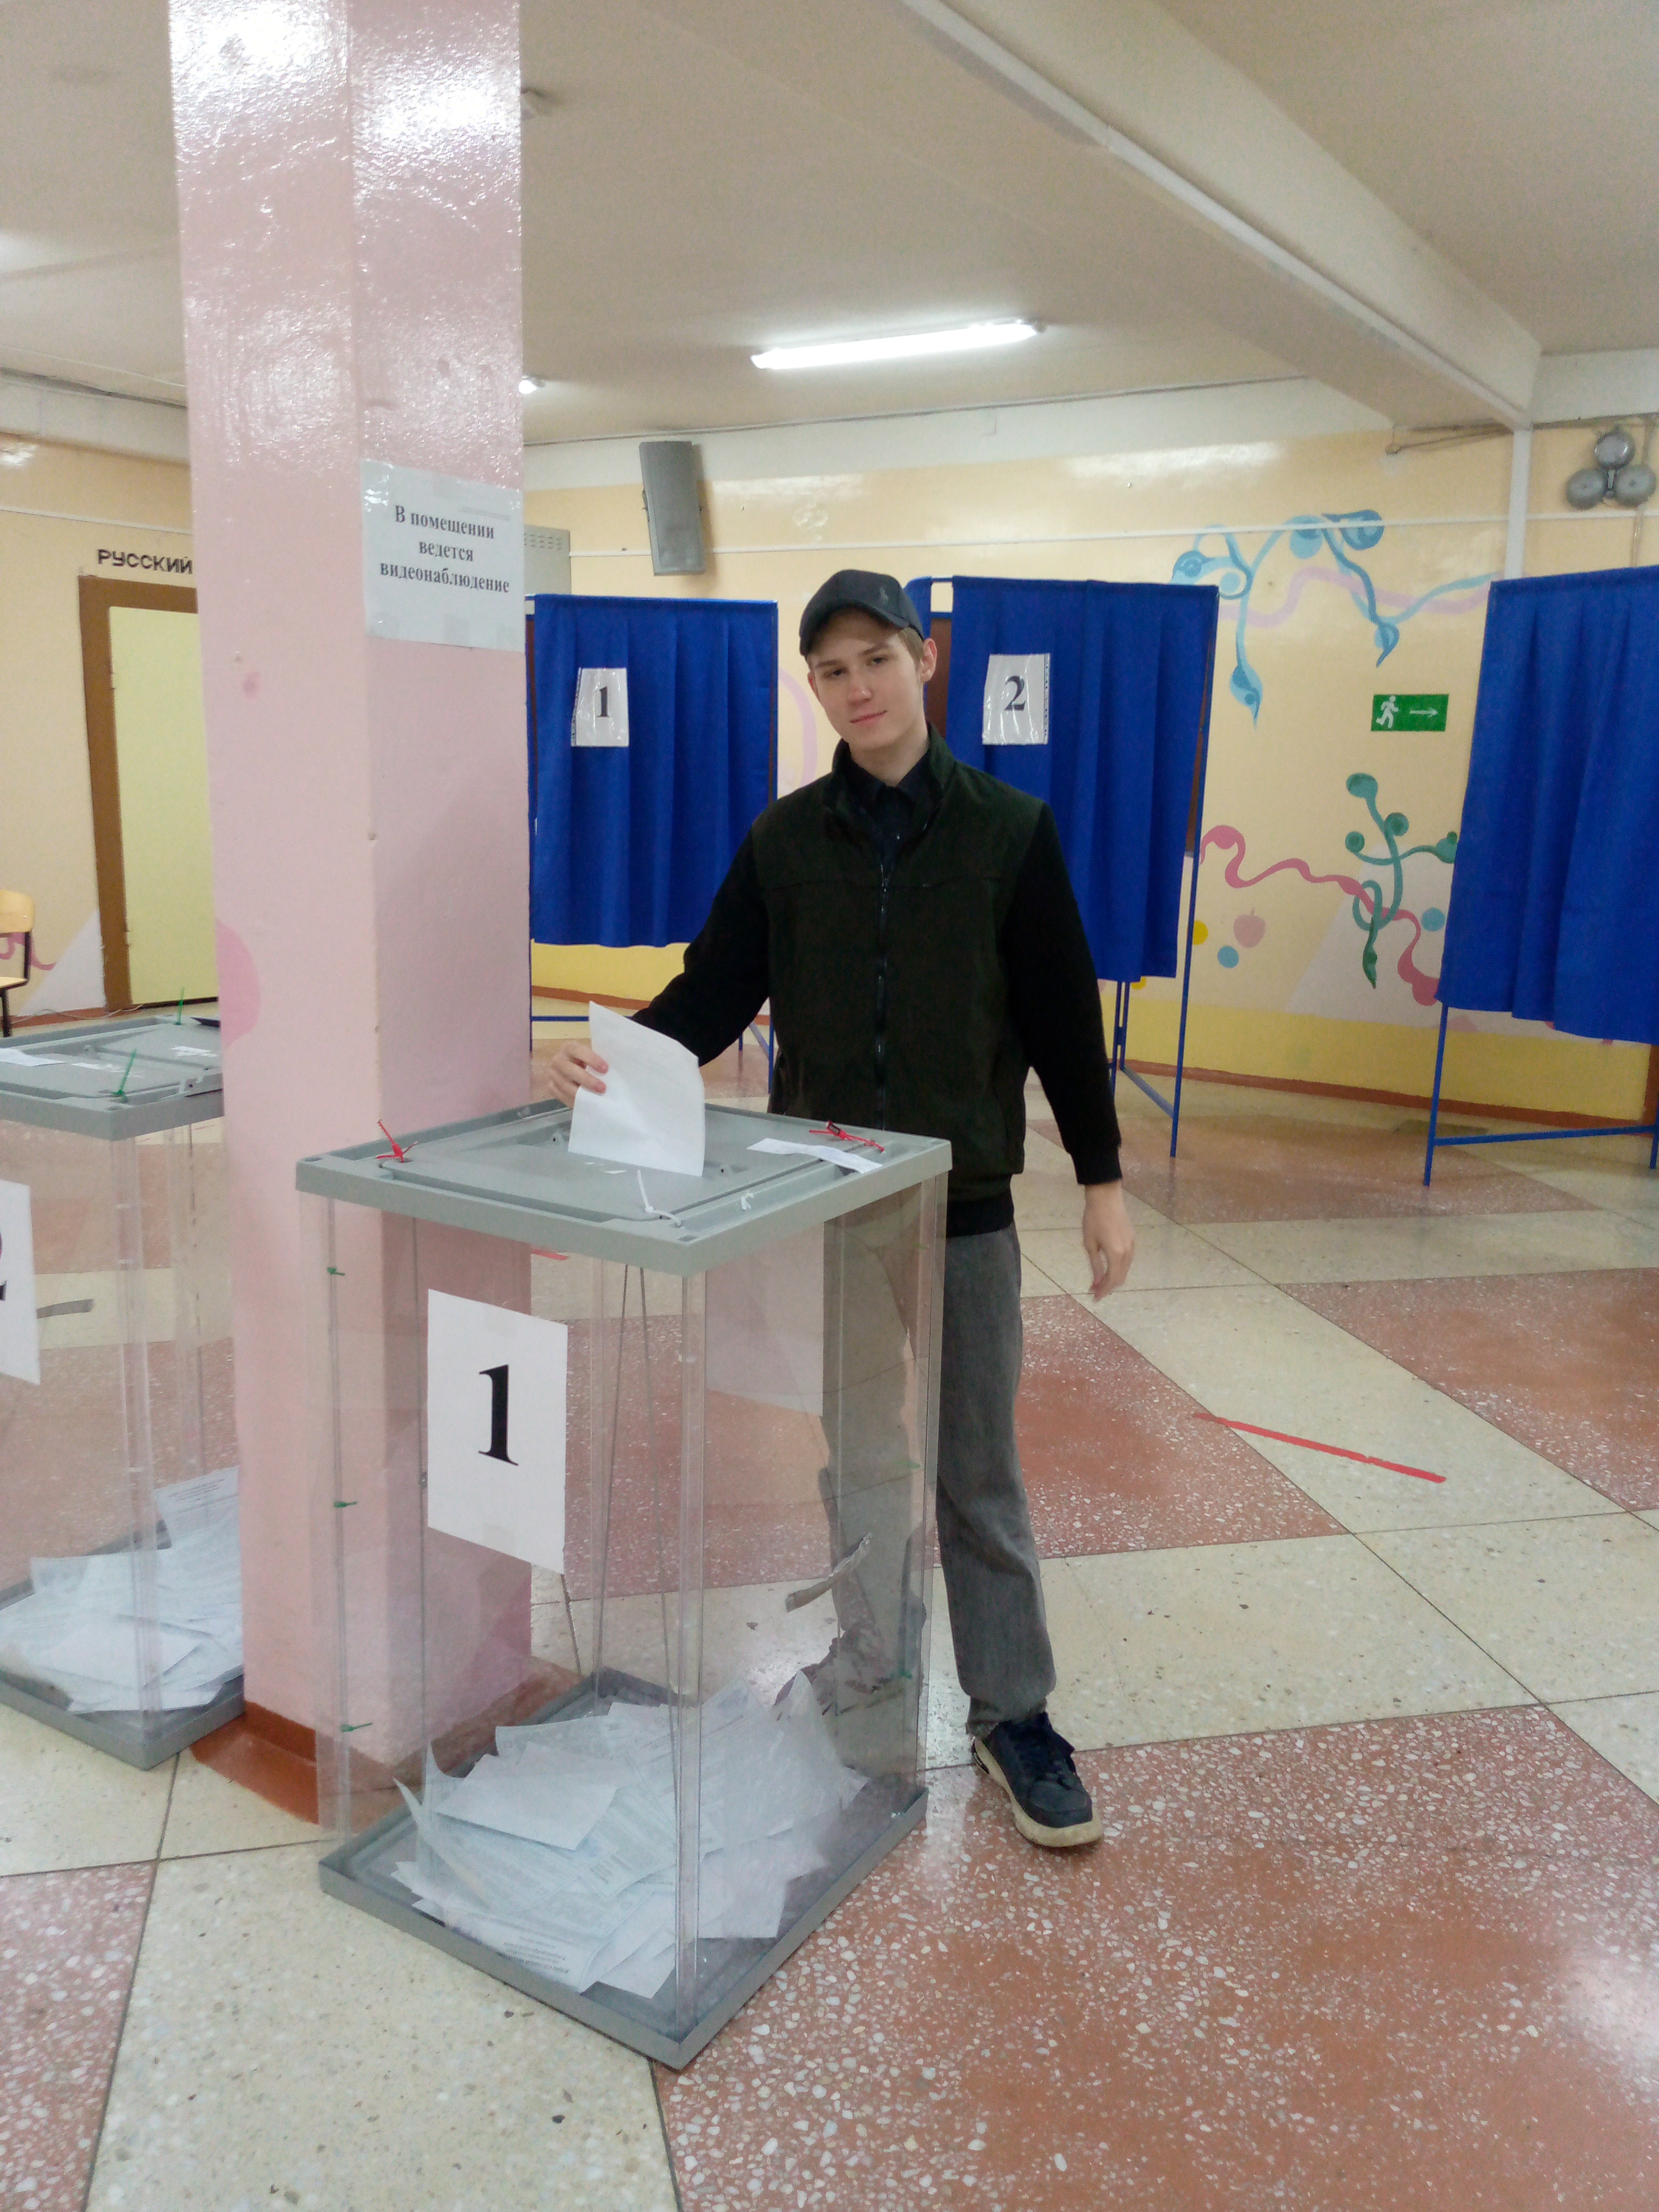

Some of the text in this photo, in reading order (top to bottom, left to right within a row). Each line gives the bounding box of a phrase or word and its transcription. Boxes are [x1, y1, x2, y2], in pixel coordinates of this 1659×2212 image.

[395, 505, 406, 523] В
[97, 549, 193, 574] РУССКИЙ
[419, 541, 474, 562] ведется
[380, 563, 509, 593] видеонаблюдение
[595, 686, 611, 718] 1
[1004, 675, 1026, 711] 2
[479, 1364, 518, 1466] 1
